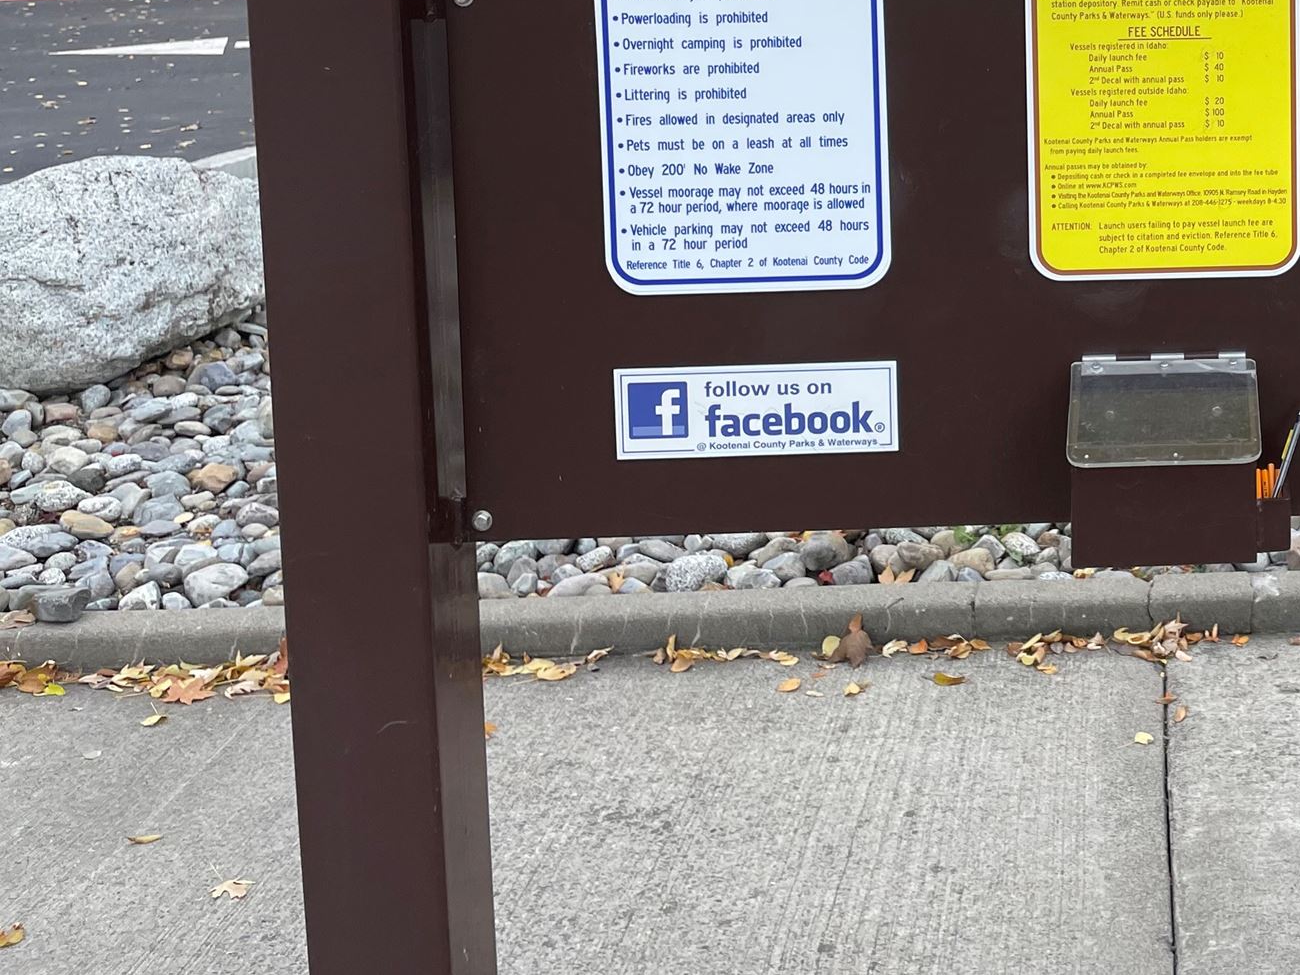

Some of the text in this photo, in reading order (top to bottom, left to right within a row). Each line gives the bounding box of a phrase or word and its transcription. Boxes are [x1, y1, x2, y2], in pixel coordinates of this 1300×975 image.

[1127, 25, 1201, 38] FEE SCHEDULE
[622, 35, 803, 54] Overnight camping is prohibited
[1069, 42, 1097, 51] Vessels
[1097, 42, 1136, 52] registered
[1088, 51, 1225, 64] Daily launch fee $ 10
[1088, 62, 1225, 74] Annual Pass $ 40
[625, 110, 845, 129] Fires allowed in designated areas only
[1098, 221, 1126, 230] Launch
[1127, 222, 1147, 230] users
[1147, 220, 1172, 231] failing
[1172, 220, 1181, 229] to
[1181, 221, 1197, 230] pay
[1197, 219, 1221, 228] vessel
[1221, 218, 1246, 227] launch
[1247, 218, 1260, 227] fee
[1261, 219, 1274, 227] are
[1098, 245, 1128, 255] Chapter
[1129, 244, 1135, 254] 2
[1136, 244, 1144, 253] of
[1145, 244, 1178, 253] Kootenai
[1179, 243, 1205, 253] County
[625, 254, 870, 271] Reference Title 6, Chapter 2 of Kootenai County Code
[703, 380, 832, 398] follow us on
[696, 438, 878, 451] @ Kootenai County Parks & Waterways
